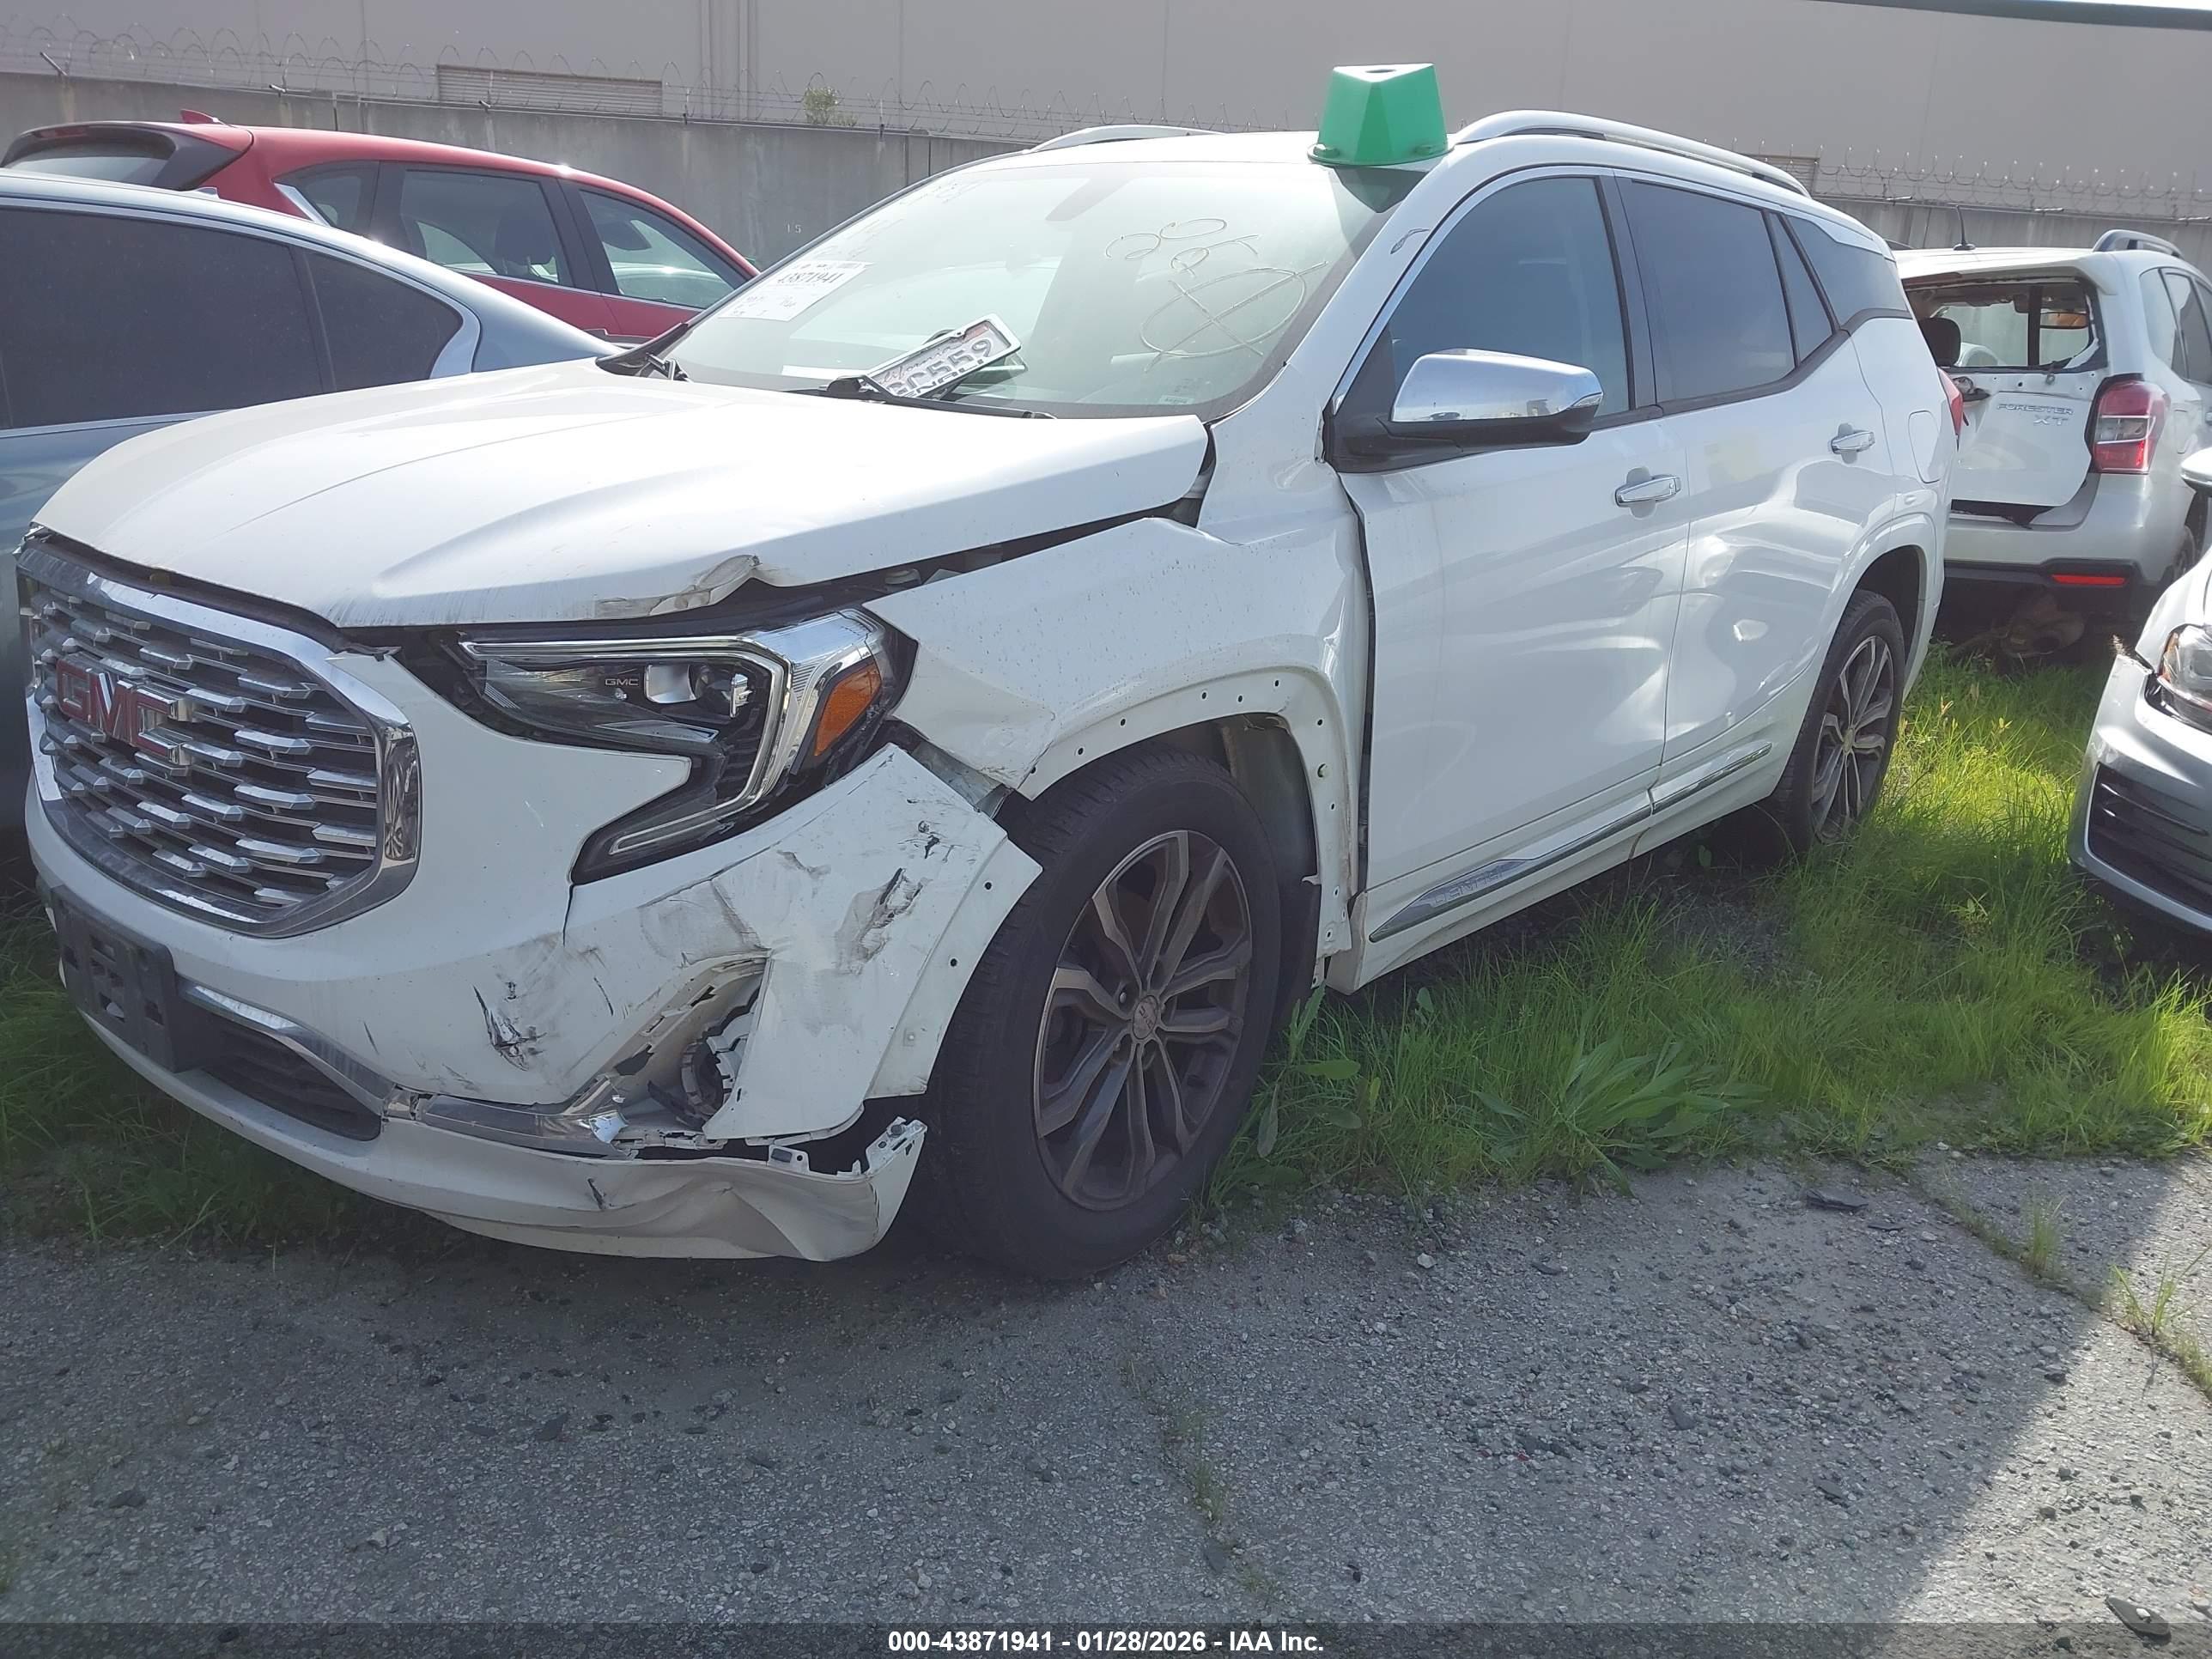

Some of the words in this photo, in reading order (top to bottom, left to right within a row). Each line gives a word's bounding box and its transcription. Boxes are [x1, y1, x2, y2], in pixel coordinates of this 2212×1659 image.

[1997, 404, 2074, 416] FORESTER
[2033, 416, 2069, 426] XT
[605, 678, 639, 686] GMC
[56, 659, 187, 764] GMC
